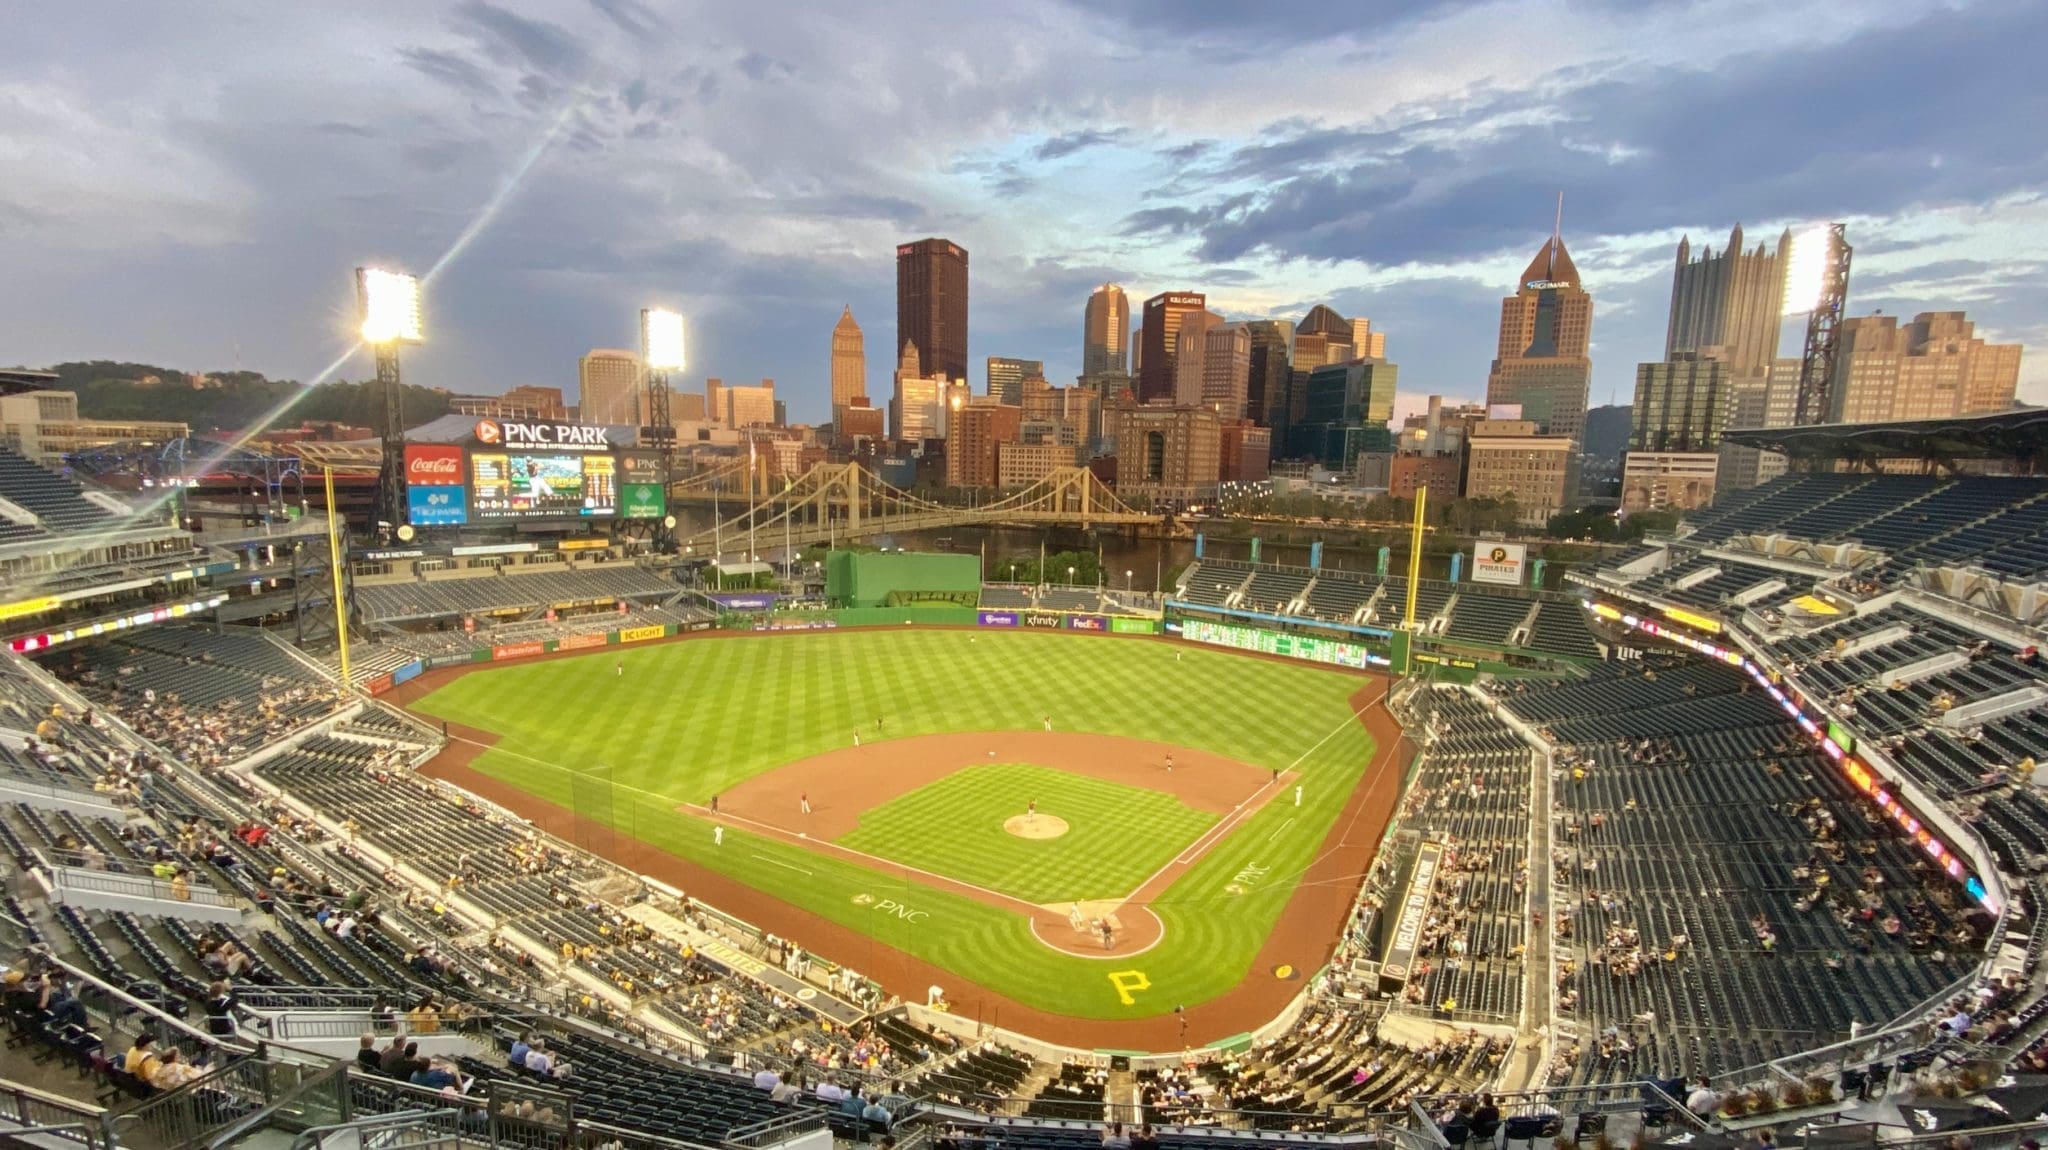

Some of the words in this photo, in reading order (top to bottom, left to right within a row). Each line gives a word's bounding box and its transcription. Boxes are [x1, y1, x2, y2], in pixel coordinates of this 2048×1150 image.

[502, 423, 551, 443] PNC
[555, 425, 609, 445] PARK
[637, 459, 660, 469] PNC
[1480, 564, 1515, 573] PIRATES
[1027, 615, 1058, 628] xfinity
[1073, 618, 1101, 630] FedEx
[625, 632, 635, 641] IC
[636, 628, 660, 638] LIGHT
[1616, 646, 1643, 660] Lite
[1233, 861, 1270, 885] PNC
[873, 899, 930, 924] PNC
[1394, 906, 1422, 951] WELCOME
[1108, 970, 1152, 1005] P
